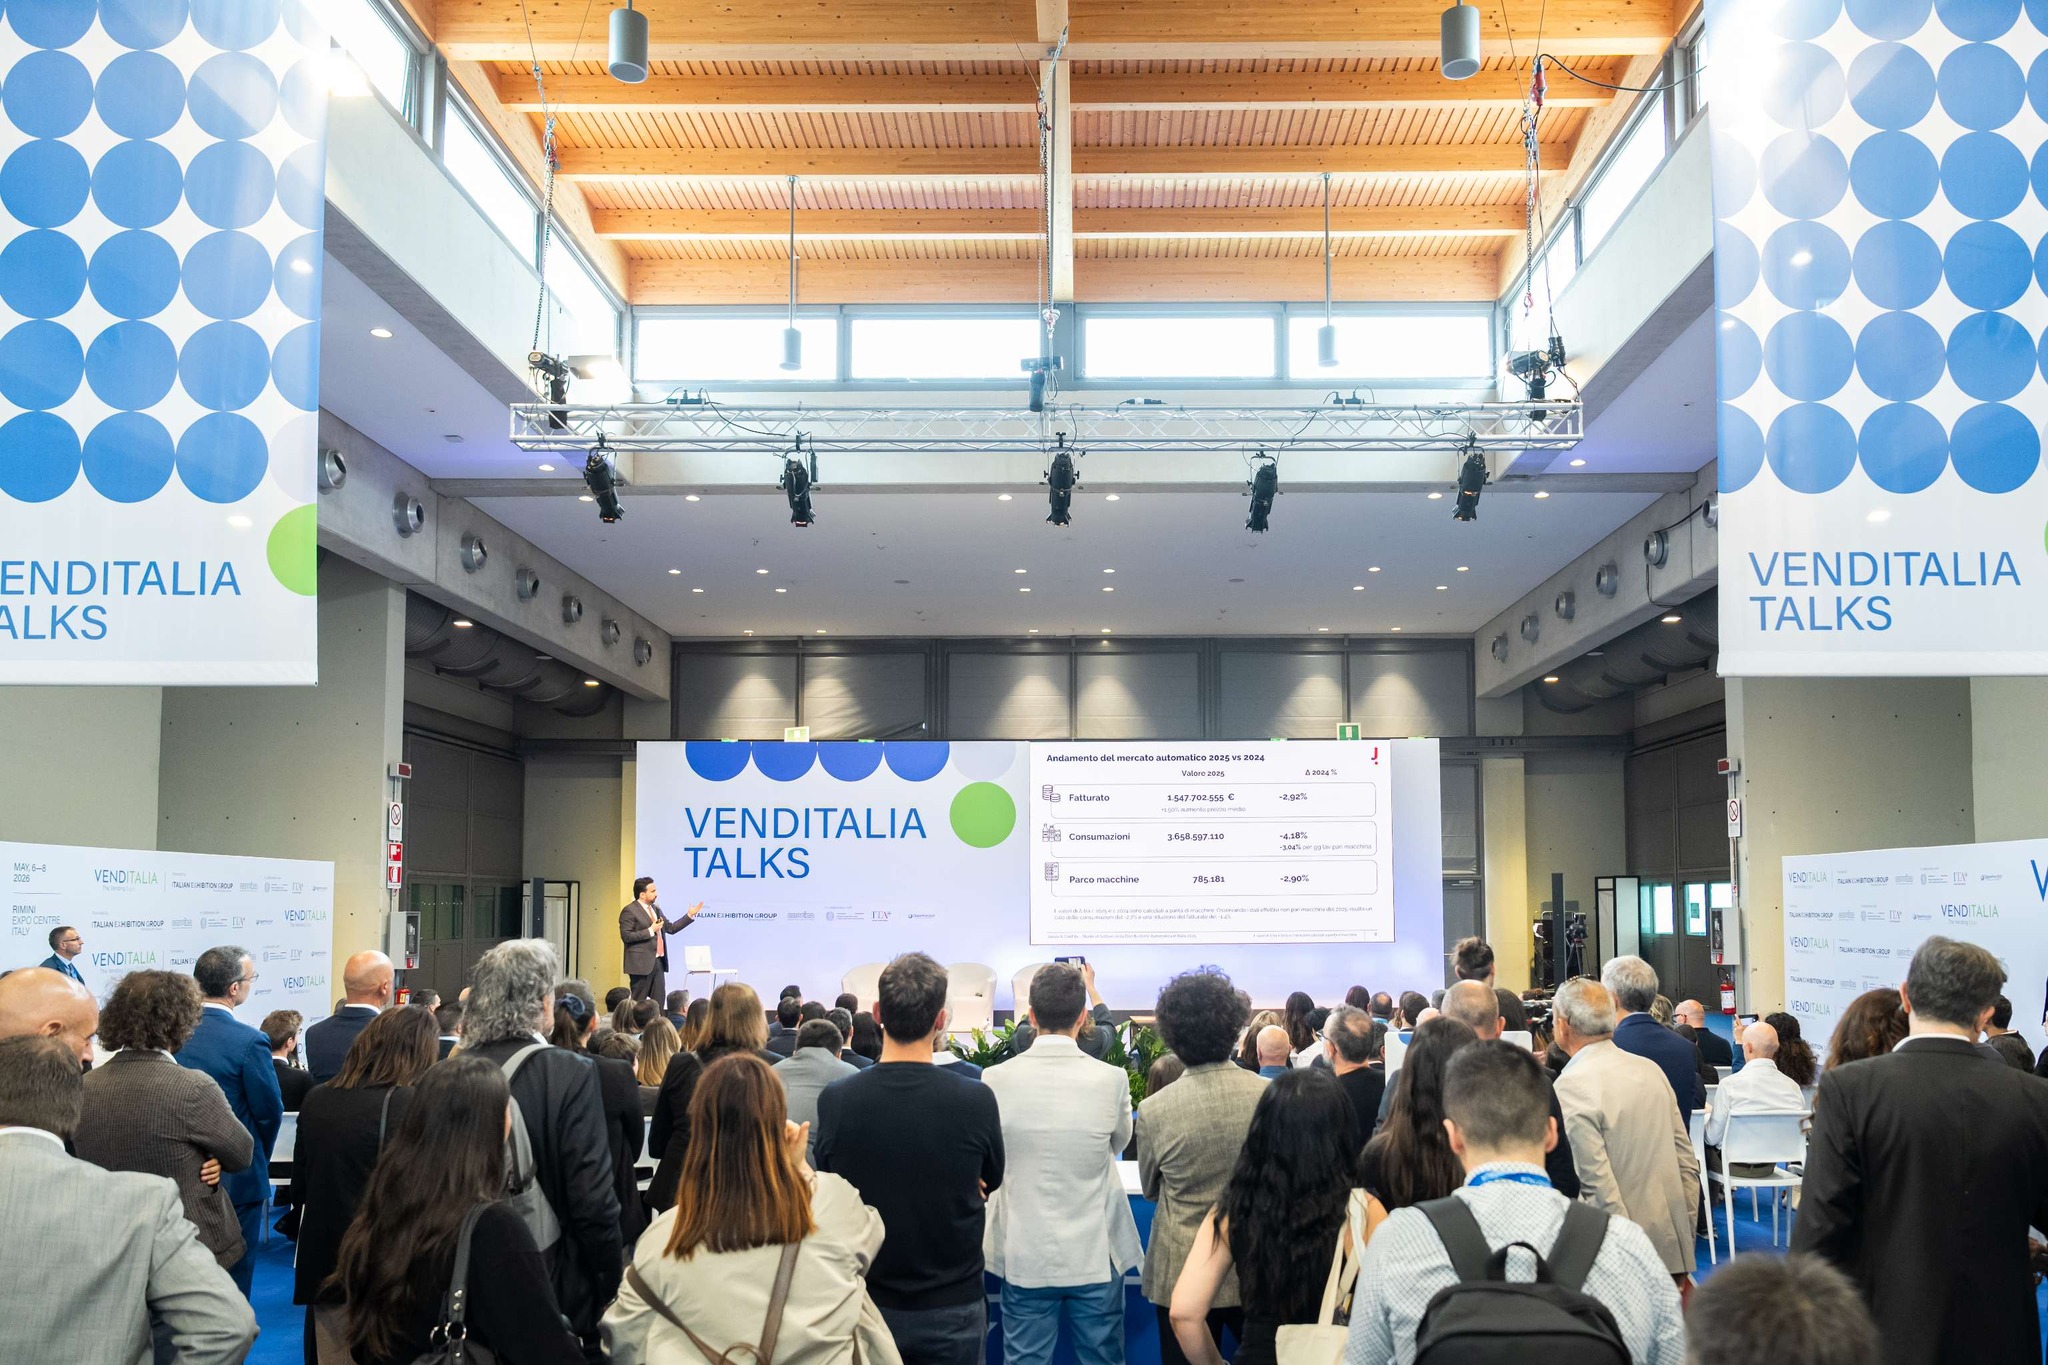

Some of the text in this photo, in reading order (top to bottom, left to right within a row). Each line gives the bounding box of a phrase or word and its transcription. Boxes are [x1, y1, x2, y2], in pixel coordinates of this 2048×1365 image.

[1748, 551, 2022, 586] VENDITALIA
[0, 560, 241, 596] ENDITALIA
[1749, 595, 1892, 631] TALKS
[0, 604, 108, 640] ALKS
[1046, 754, 1099, 762] Andamento
[1100, 754, 1115, 762] del
[1156, 754, 1207, 762] automatico
[1069, 794, 1110, 802] Fatturato
[1167, 793, 1235, 802] 1.547.702.555 €
[684, 807, 927, 839] VENDITALIA
[1069, 832, 1131, 841] Consumazioni
[1167, 833, 1225, 841] 3.658.597.110
[13, 863, 31, 873] MAY,
[684, 847, 810, 879] TALKS
[13, 873, 31, 883] 2026
[94, 869, 158, 884] VENDITALIA
[1096, 875, 1140, 883] macchine
[1192, 876, 1225, 884] 785.181
[1788, 872, 1828, 883] VENDITALIA
[12, 905, 36, 914] RIMINI
[1940, 904, 1999, 918] VENDITALIA
[12, 915, 61, 925] EXPO CENTRE
[284, 909, 327, 921] VENDITALIA
[91, 920, 114, 928] ITALIAN
[114, 920, 146, 928] EXHIBITION
[11, 927, 30, 936] ITALY
[1790, 936, 1829, 949] VENDITALIA
[92, 951, 157, 967] VENDITALIA
[169, 958, 189, 966] ITALIAN
[283, 976, 325, 989] VENDITALIA
[1791, 1000, 1831, 1015] VENDITALIA
